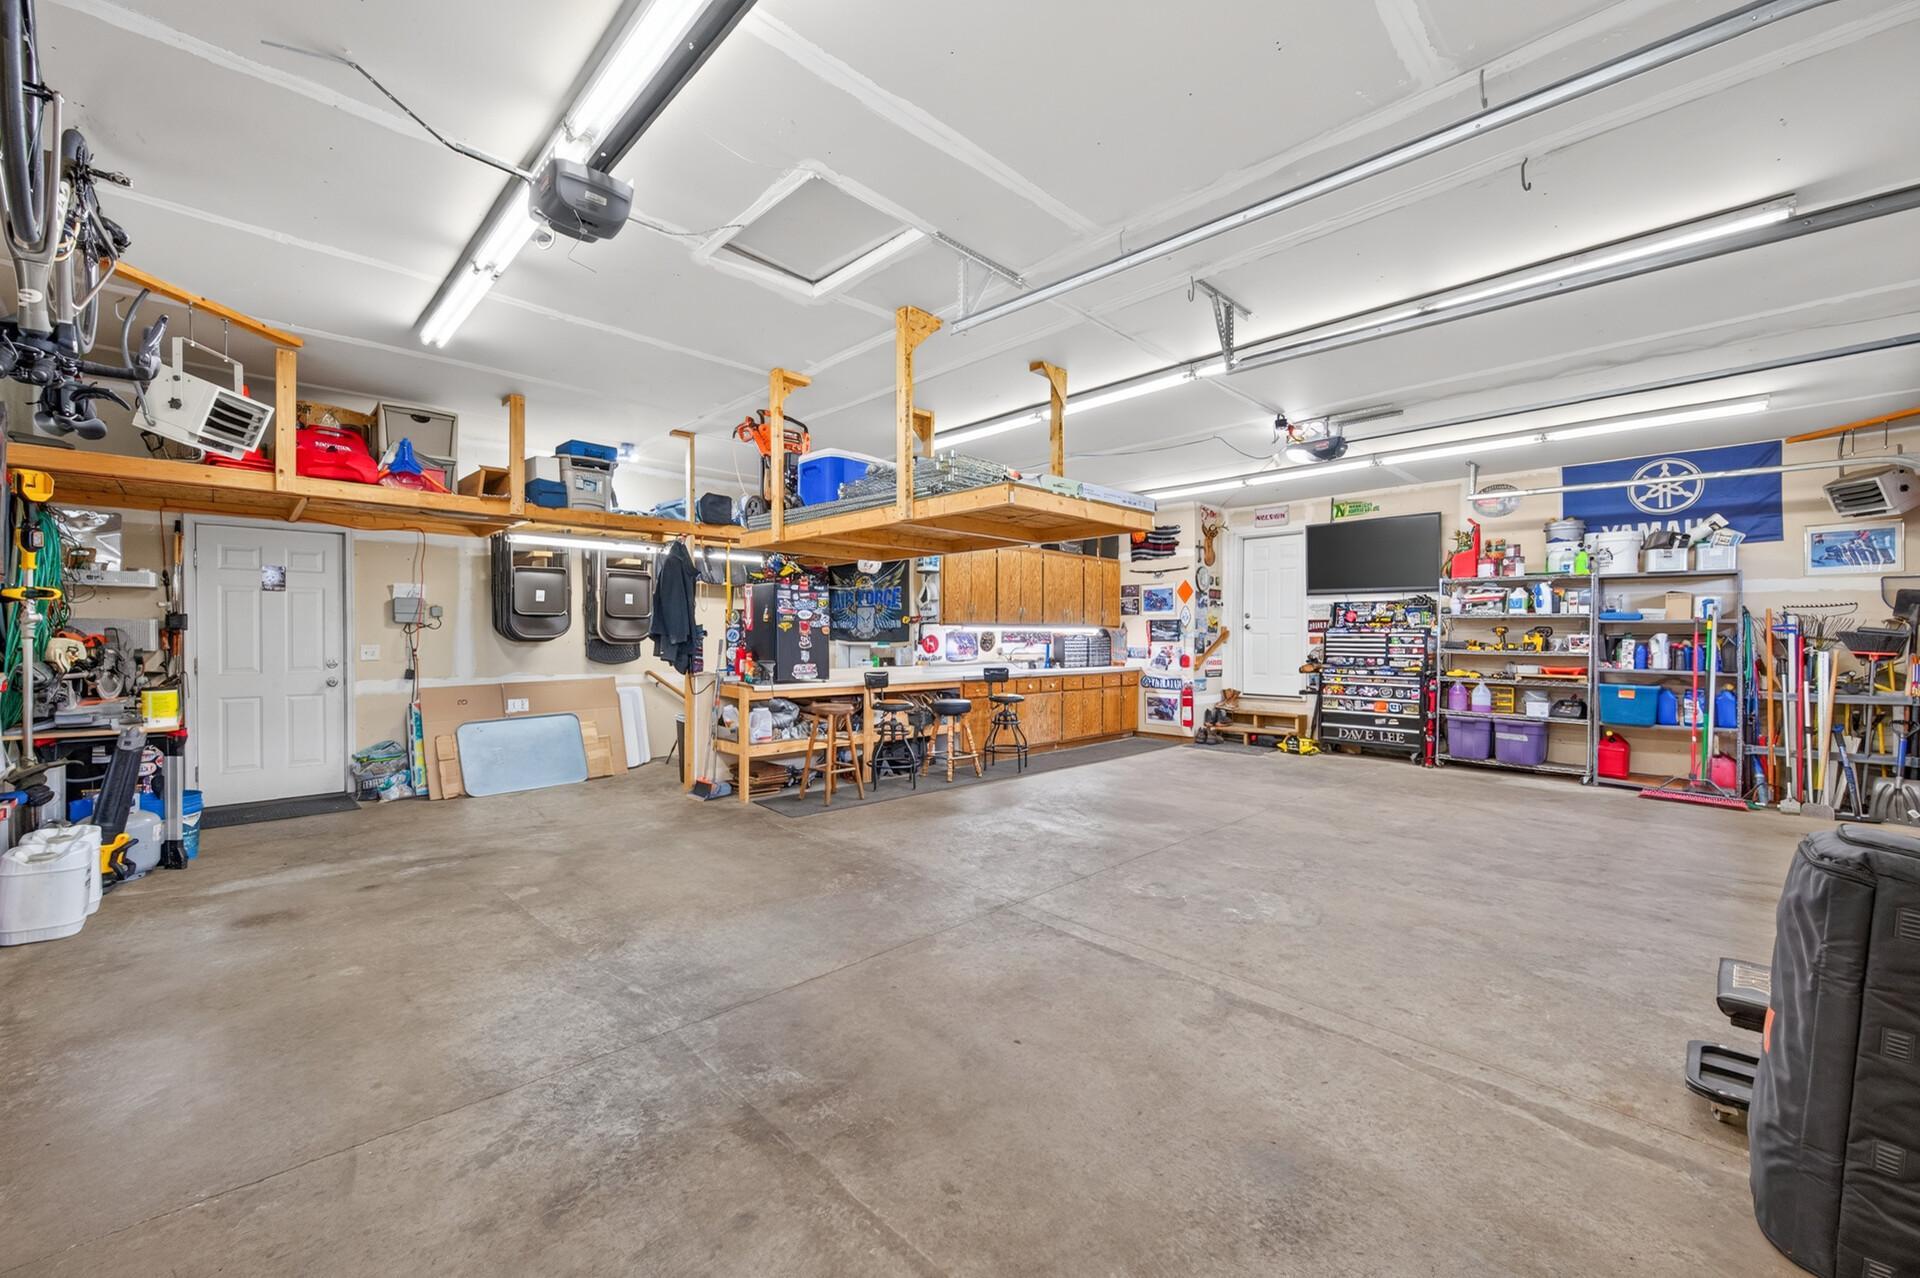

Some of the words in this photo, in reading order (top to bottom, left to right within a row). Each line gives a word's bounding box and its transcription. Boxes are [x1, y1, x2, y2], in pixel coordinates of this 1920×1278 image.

[857, 586, 902, 610] FORCE
[1338, 727, 1375, 741] DAVE
[1379, 731, 1405, 744] LEE
